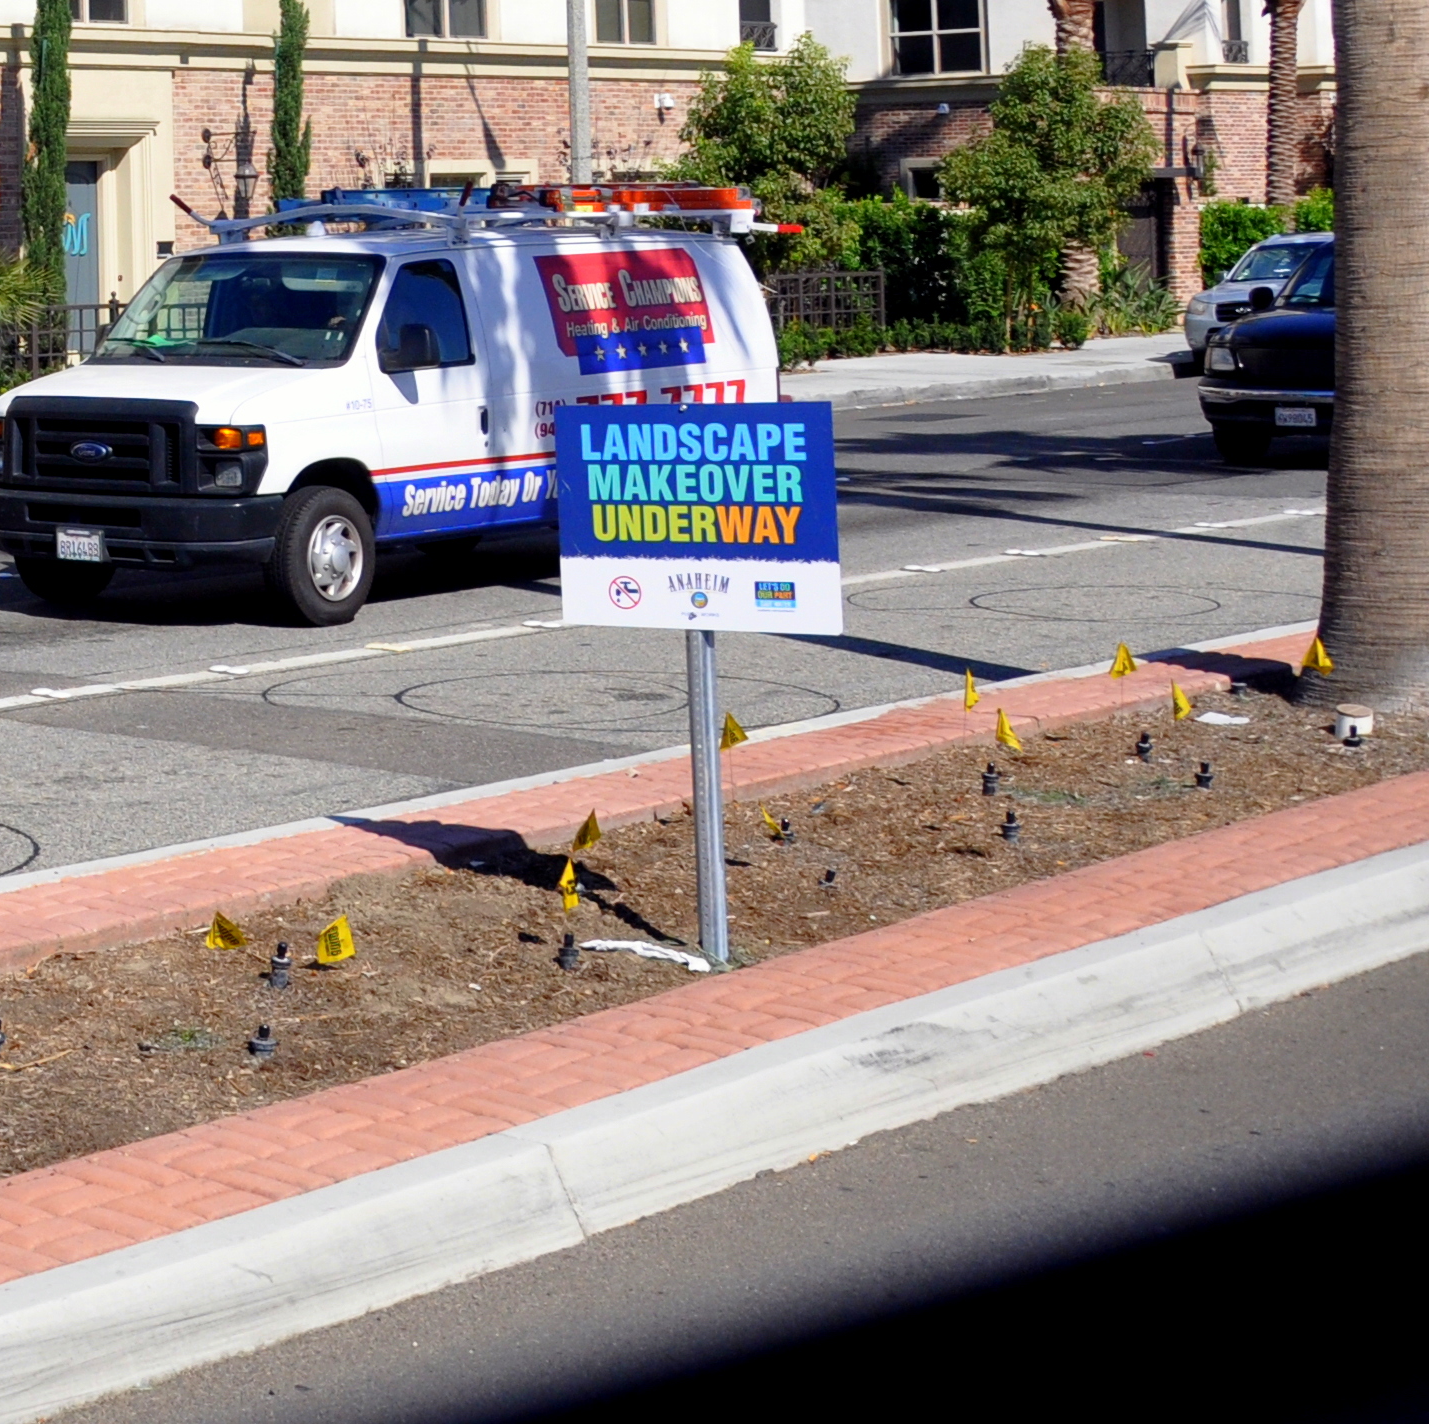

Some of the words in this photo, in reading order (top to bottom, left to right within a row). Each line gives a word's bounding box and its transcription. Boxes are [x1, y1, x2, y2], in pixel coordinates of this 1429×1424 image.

[566, 319, 608, 338] Heating
[612, 318, 620, 333] &
[624, 315, 639, 333] Air
[643, 311, 707, 331] Conditioning
[346, 398, 372, 411] #10-75
[581, 423, 807, 461] LANDSCAPE
[402, 481, 466, 517] Service
[469, 475, 520, 508] Today
[521, 471, 543, 503] Or
[587, 464, 803, 502] MAKEOVER
[592, 505, 801, 544] UNDERWAY
[668, 572, 730, 593] ANAHEIM
[758, 582, 778, 591] LET'S
[780, 582, 791, 591] DO
